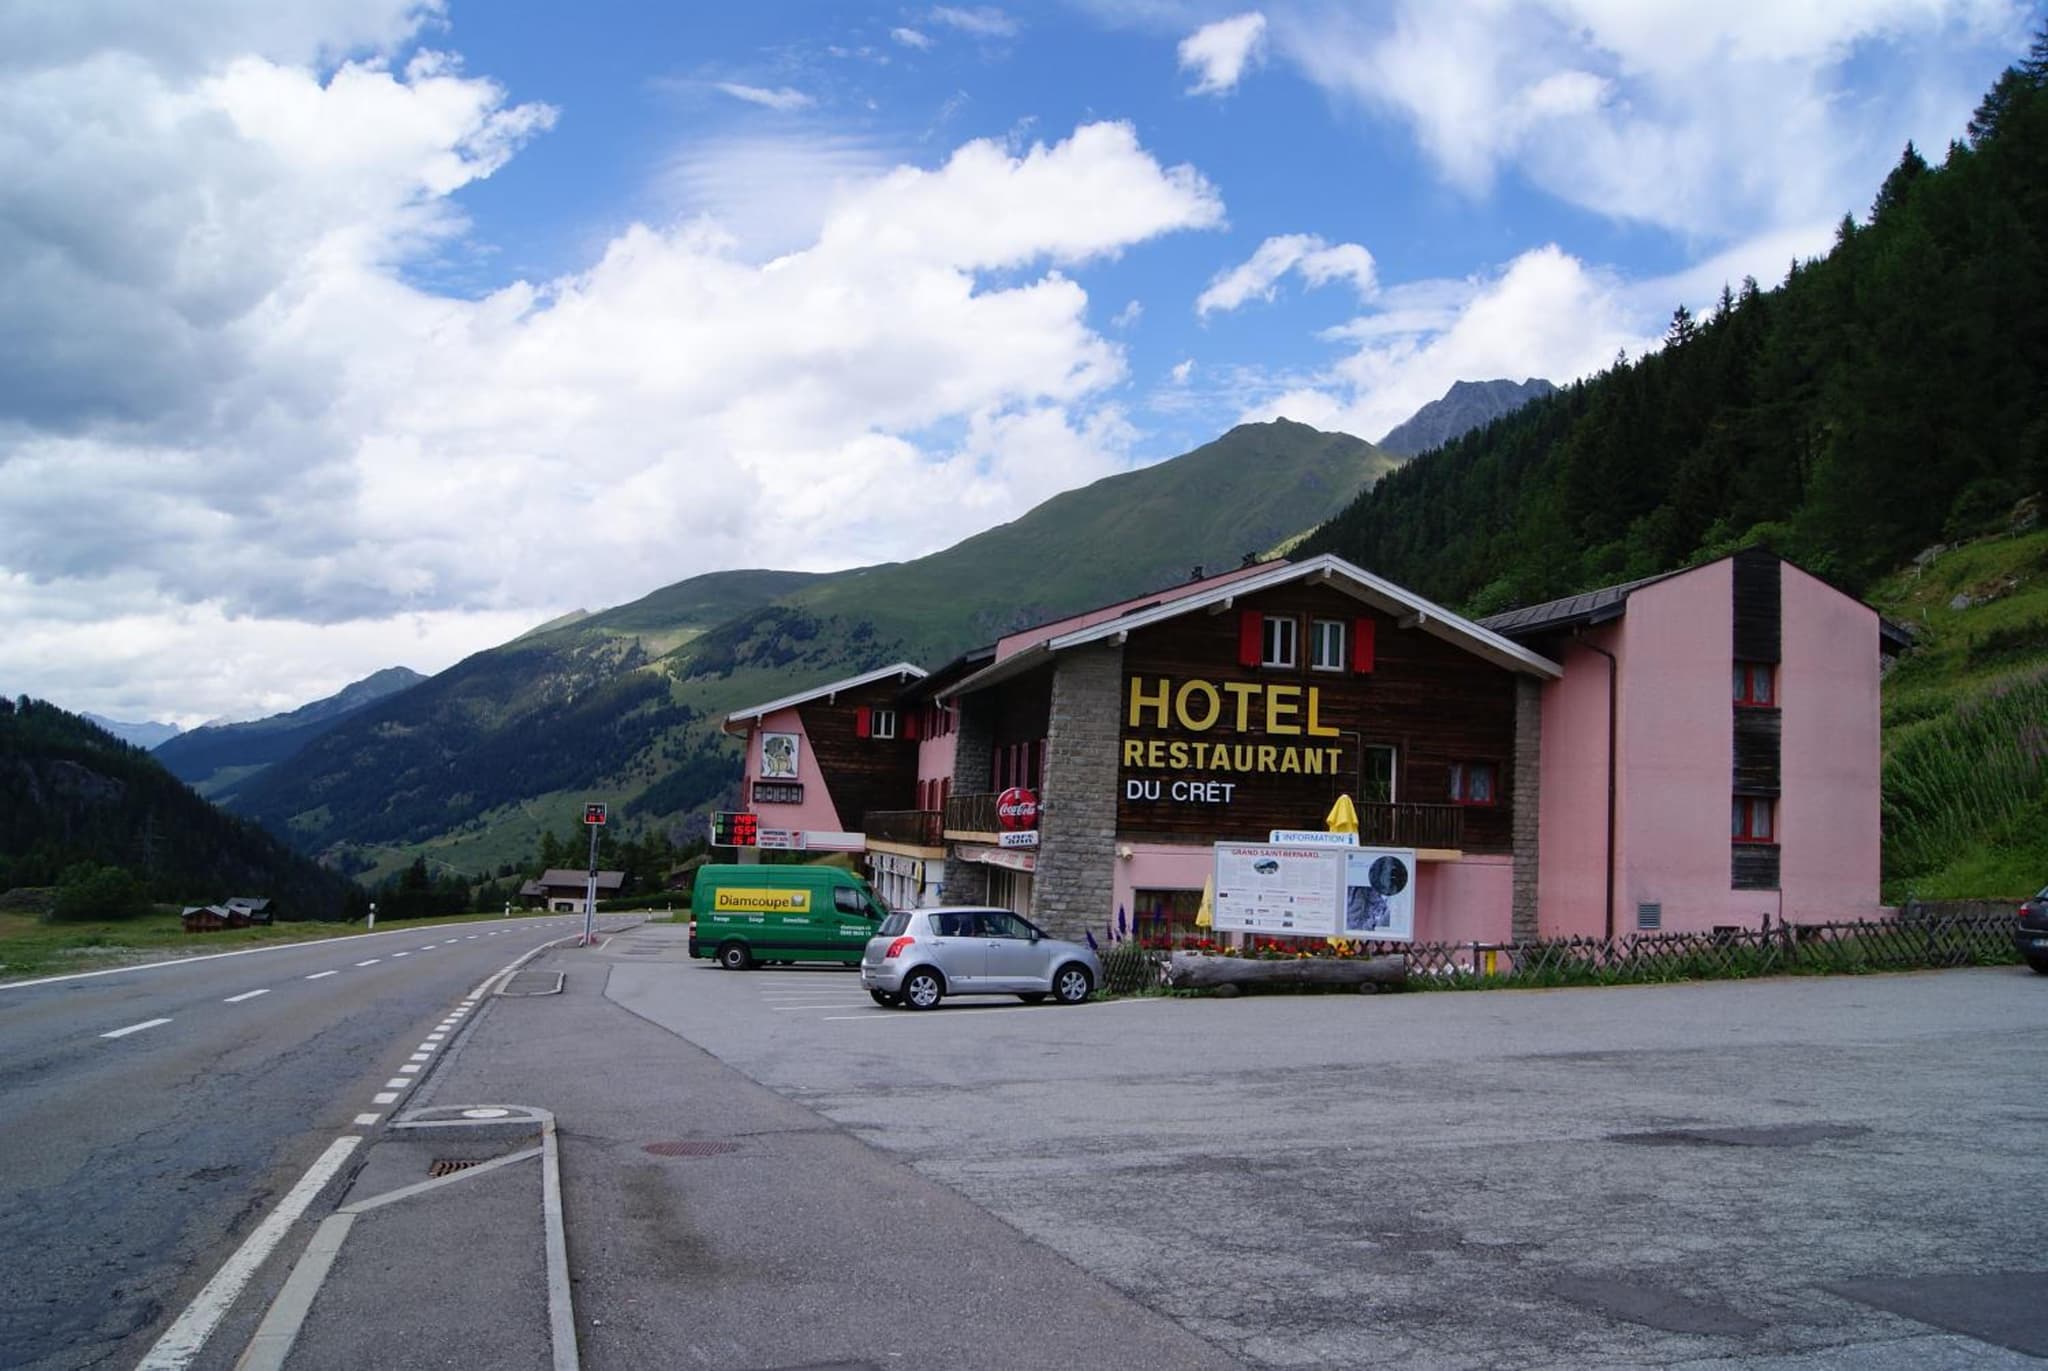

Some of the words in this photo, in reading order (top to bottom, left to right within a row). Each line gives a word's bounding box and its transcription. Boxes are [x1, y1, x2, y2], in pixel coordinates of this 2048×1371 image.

[1128, 676, 1341, 738] HOTEL
[1122, 738, 1343, 776] RESTAURANT
[1126, 780, 1160, 801] DU
[1171, 780, 1236, 804] CRÊT
[1282, 833, 1345, 843] INFORMATION
[1232, 848, 1259, 856] GRAND
[719, 894, 790, 910] Diamcoupe
